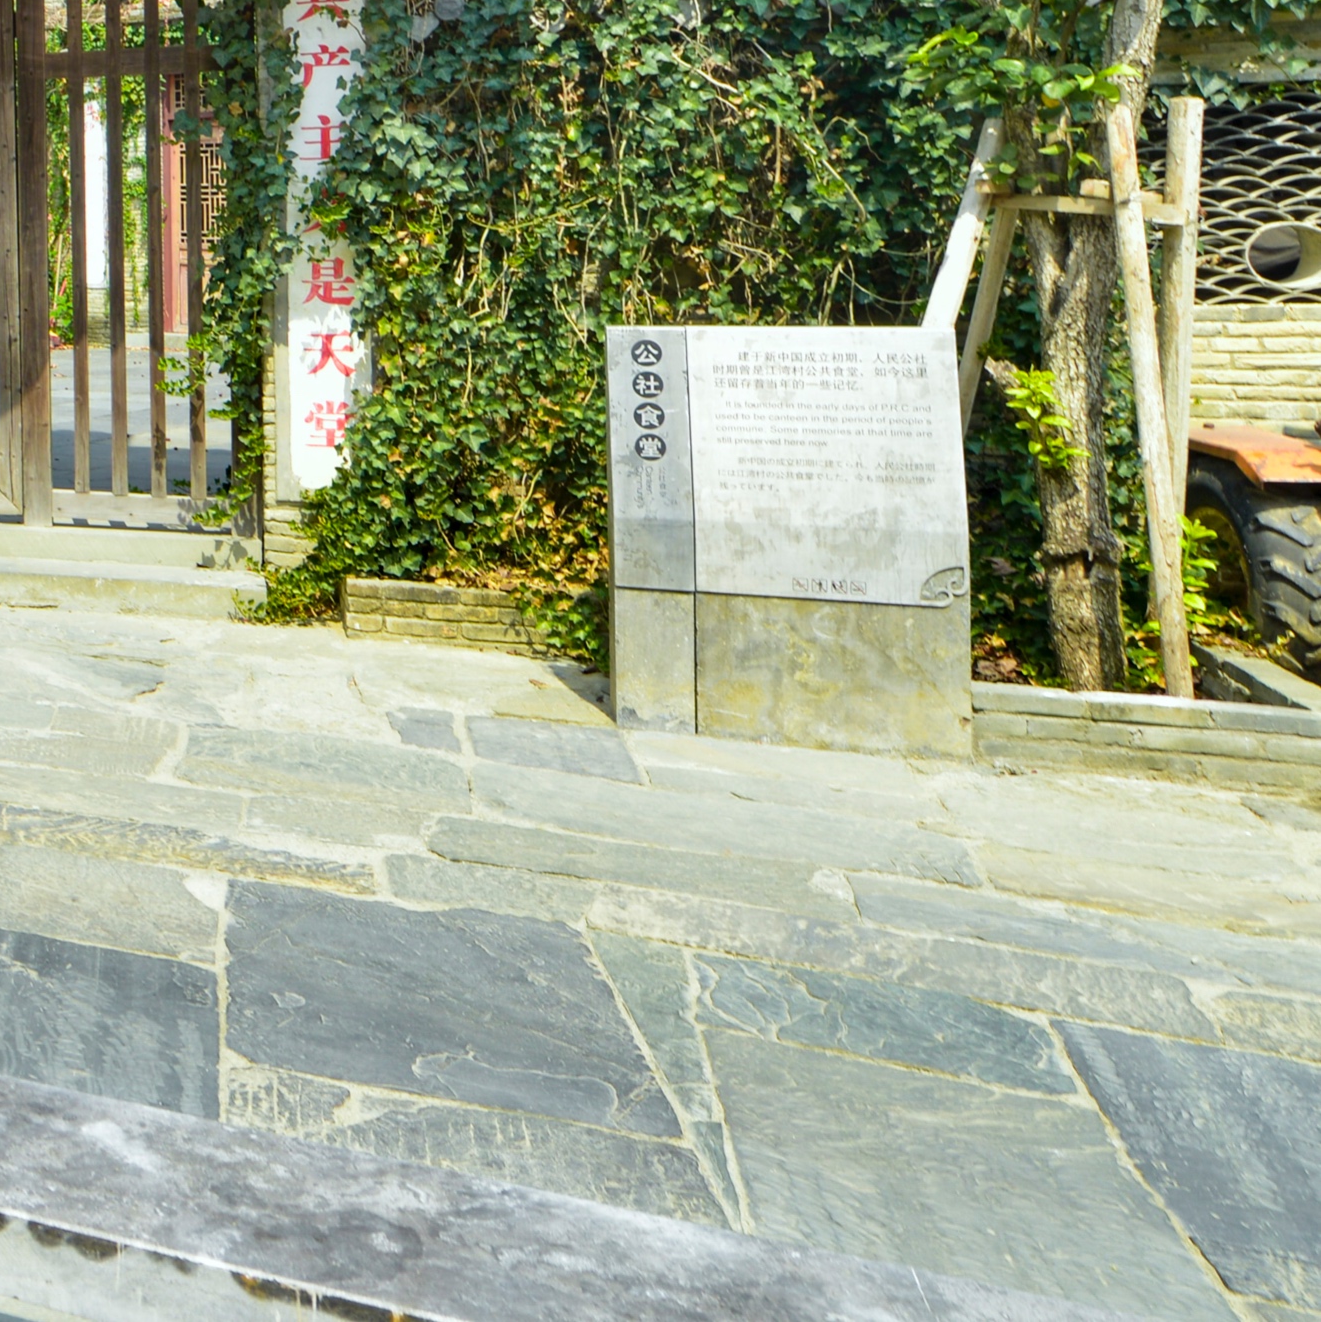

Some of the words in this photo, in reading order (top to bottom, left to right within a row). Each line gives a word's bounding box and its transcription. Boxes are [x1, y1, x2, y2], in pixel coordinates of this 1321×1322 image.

[633, 342, 664, 459] 公社食堂
[734, 400, 742, 409] is
[744, 400, 783, 409] founded
[785, 401, 795, 409] in
[797, 402, 812, 410] the
[815, 403, 839, 412] early
[842, 403, 865, 412] days
[868, 403, 878, 411] of
[912, 404, 932, 413] and
[715, 412, 739, 421] used
[741, 413, 750, 421] to
[753, 413, 766, 421] be
[768, 414, 808, 423] canteen
[811, 414, 820, 423] in
[822, 415, 838, 423] the
[841, 415, 873, 425] period
[876, 416, 886, 424] of
[889, 416, 932, 426] people's
[770, 425, 799, 434] Some
[801, 426, 852, 436] memories
[854, 428, 865, 436] at
[867, 428, 888, 437] that
[890, 428, 913, 438] time
[915, 430, 933, 439] are
[716, 436, 733, 444] still
[734, 437, 782, 447] preserved
[783, 438, 806, 447] here
